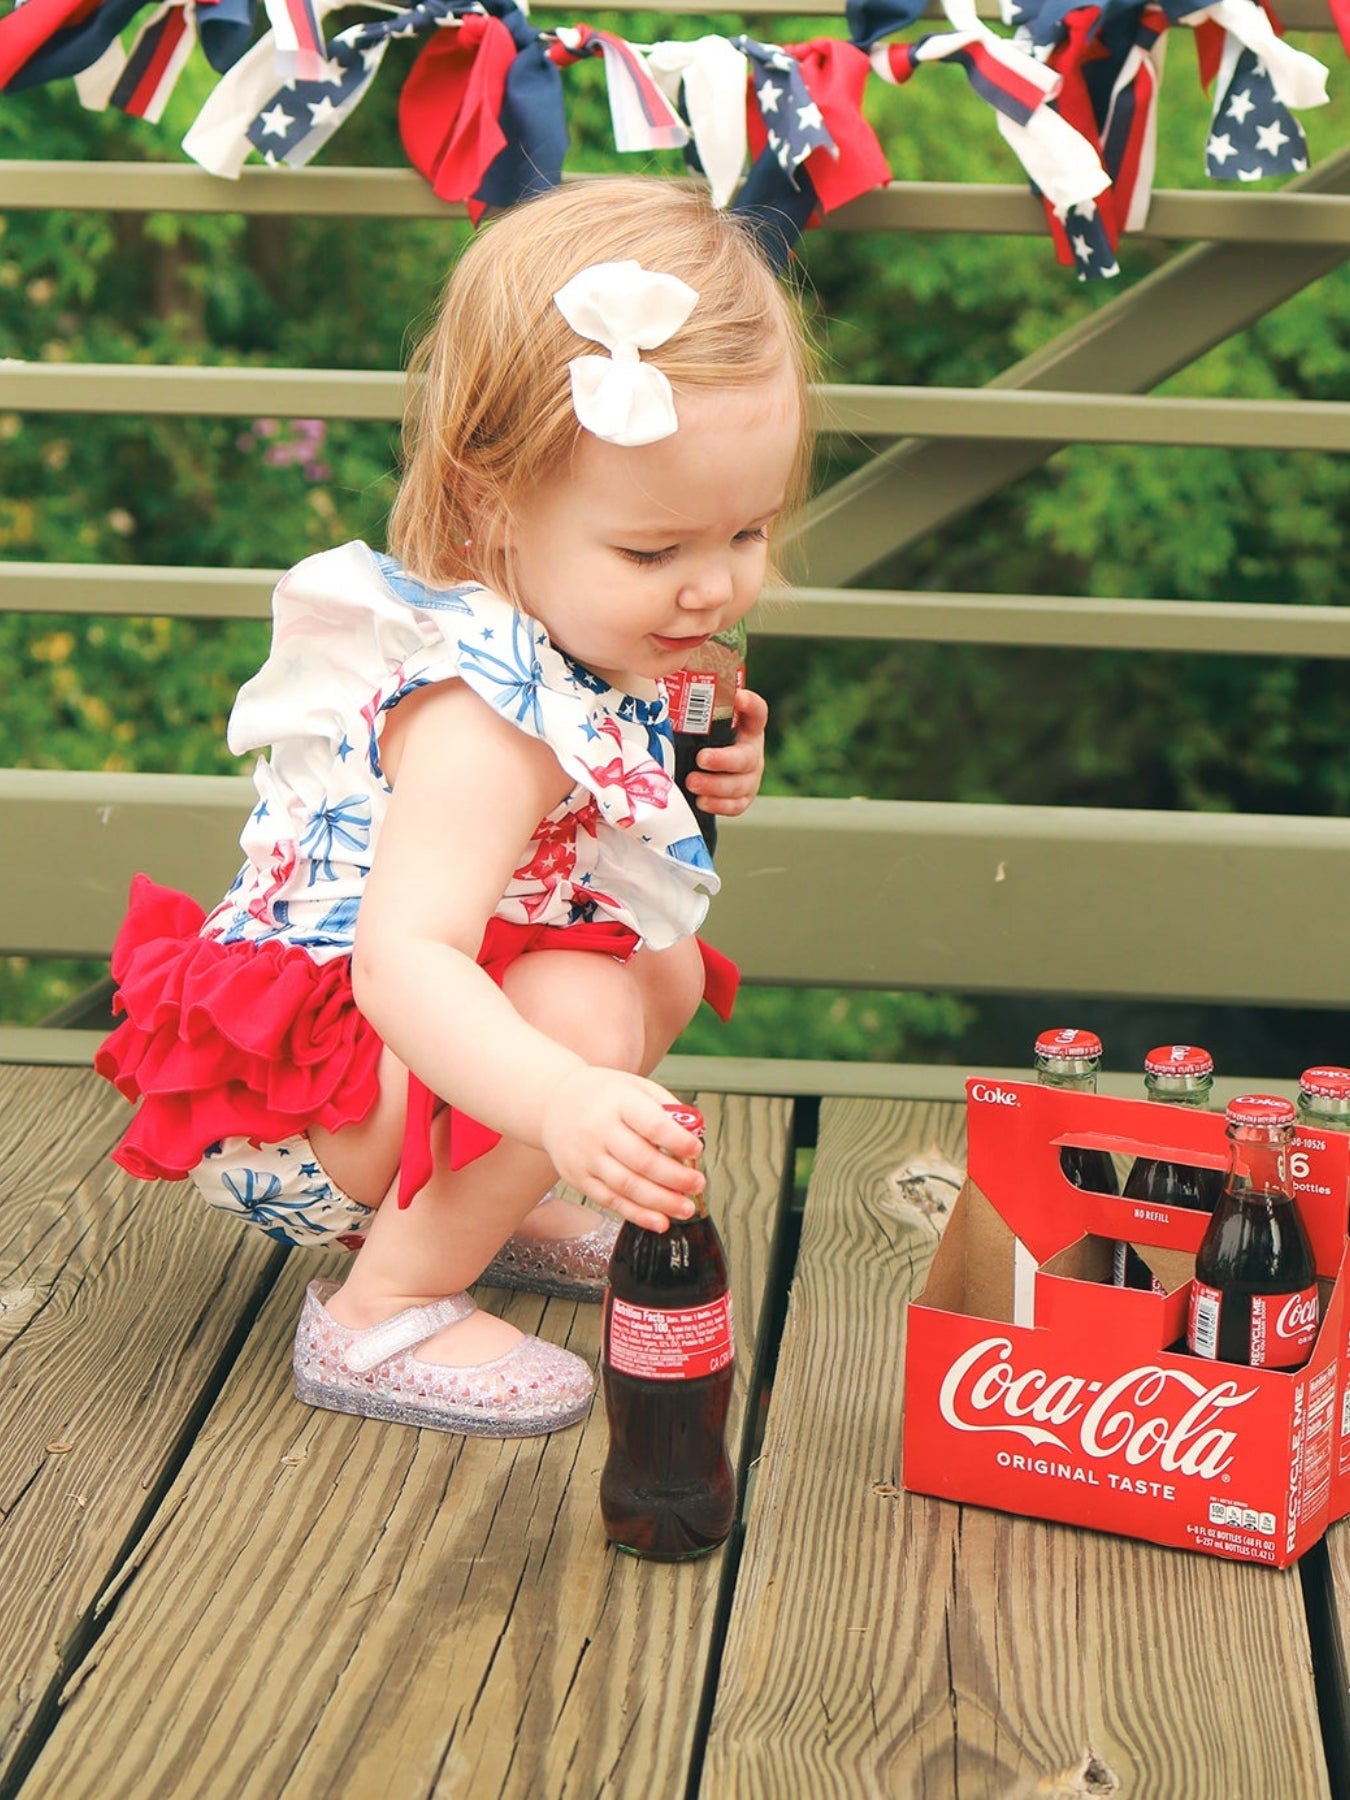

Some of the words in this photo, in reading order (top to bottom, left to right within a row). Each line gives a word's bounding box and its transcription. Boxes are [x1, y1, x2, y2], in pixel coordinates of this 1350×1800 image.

[1290, 1152, 1310, 1178] 6
[1292, 1181, 1331, 1195] bottles
[1134, 1208, 1145, 1219] NO
[1145, 1211, 1169, 1223] REFILL
[1252, 1297, 1262, 1315] ME
[643, 1311, 665, 1324] Facts
[1250, 1316, 1261, 1366] RECYCLE
[710, 1356, 719, 1371] CA
[940, 1338, 1260, 1479] Coca-Cola
[1293, 1383, 1304, 1428] ME
[996, 1452, 1099, 1485] ORIGINAL
[1108, 1474, 1175, 1500] TASTE
[1286, 1429, 1302, 1554] RECYCLE
[1212, 1504, 1225, 1515] 100
[1200, 1527, 1206, 1536] FL
[1207, 1528, 1216, 1538] OZ
[1217, 1530, 1242, 1544] BOTTLES
[1255, 1539, 1262, 1549] FL
[1225, 1542, 1250, 1556] BOTTLES
